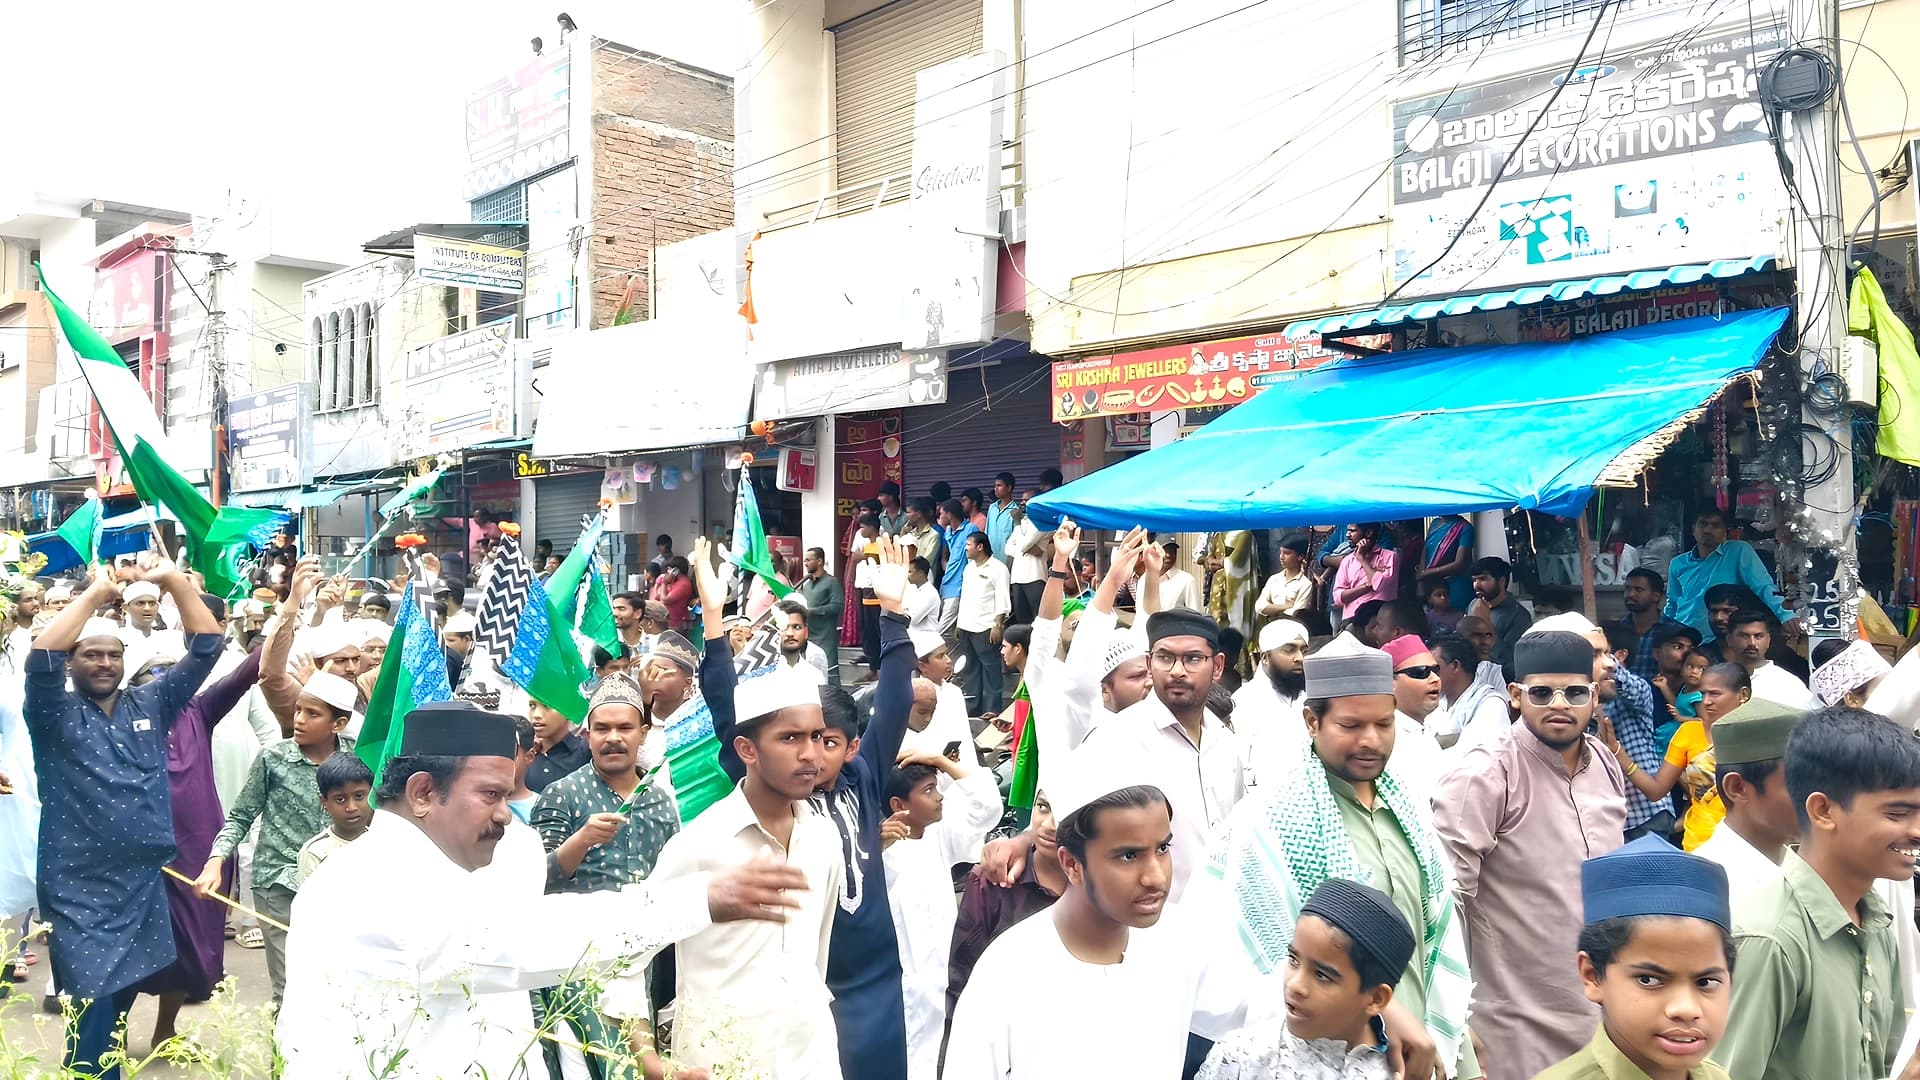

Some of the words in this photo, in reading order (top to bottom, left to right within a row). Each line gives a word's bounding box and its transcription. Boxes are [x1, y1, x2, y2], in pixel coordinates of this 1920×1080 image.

[1401, 147, 1492, 194] BALAJI
[1502, 108, 1717, 176] DECORATIONS
[1574, 307, 1640, 335] BALAJI
[1056, 371, 1073, 389] SRI
[1123, 357, 1188, 385] JEWELLERS
